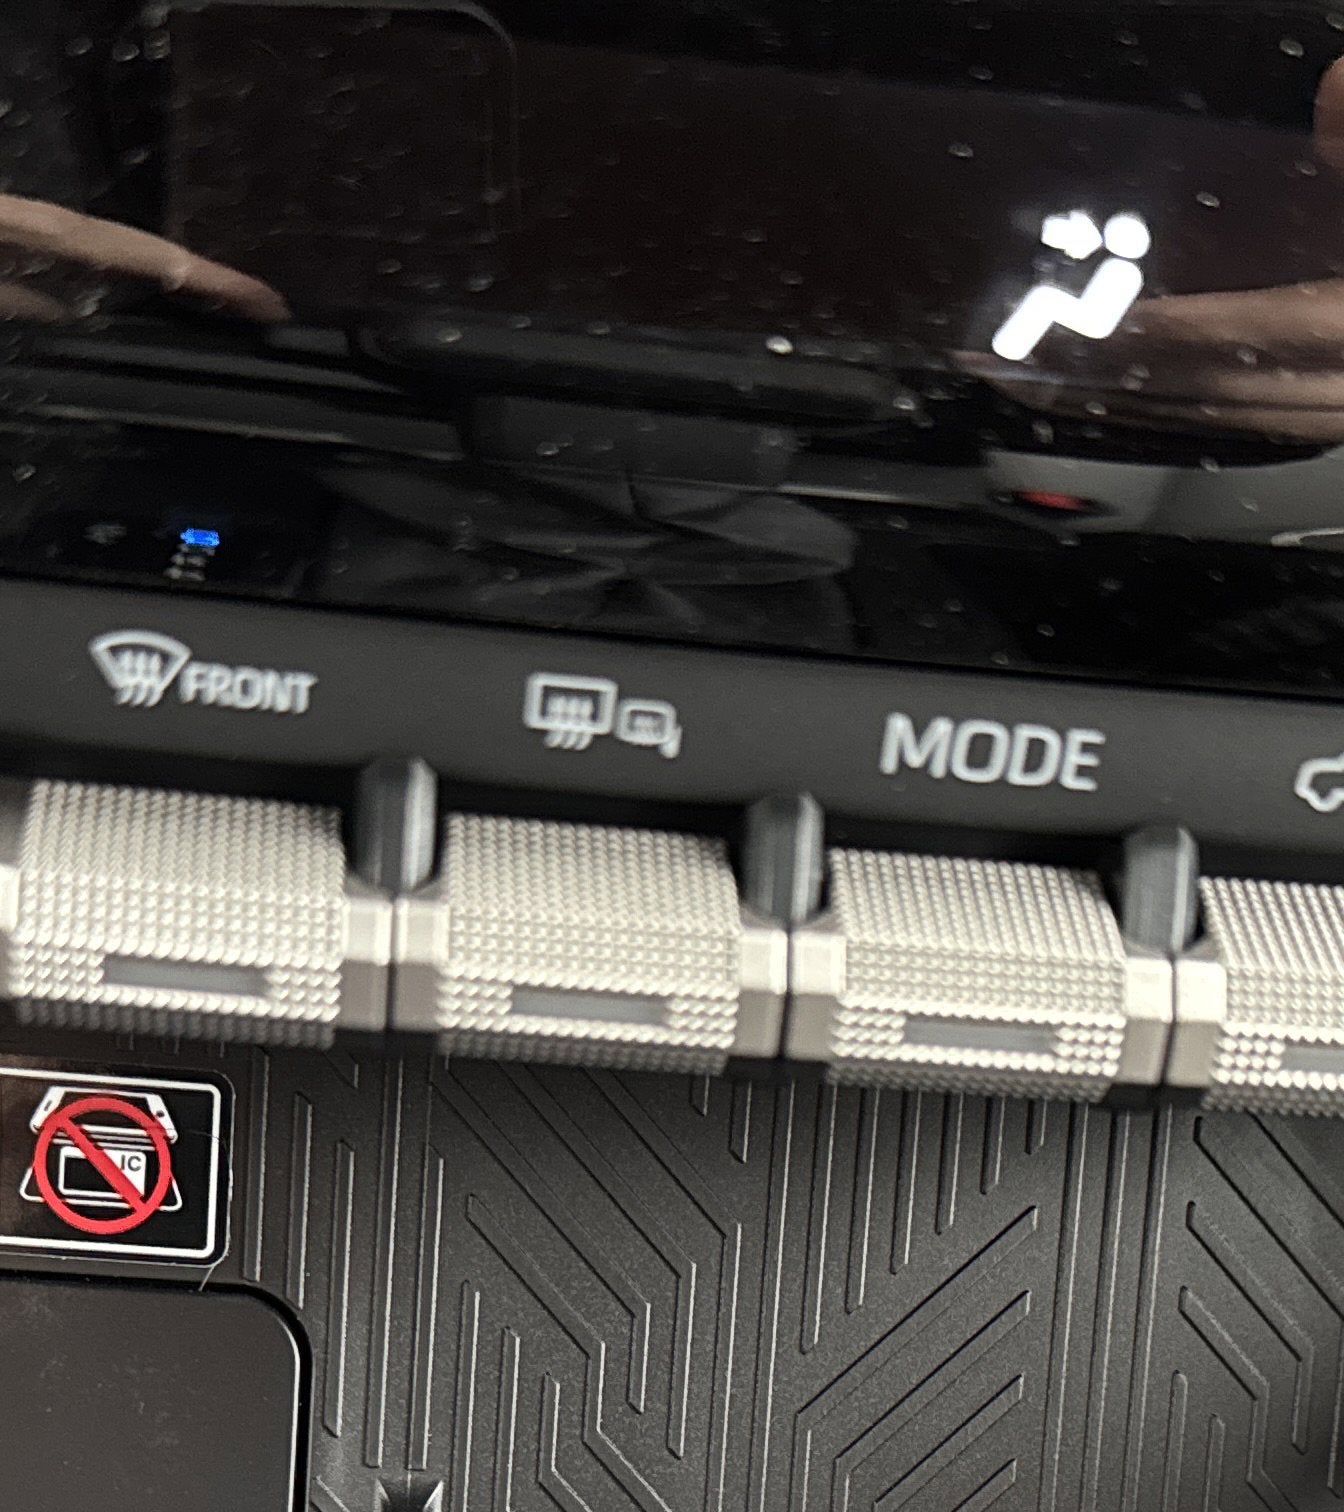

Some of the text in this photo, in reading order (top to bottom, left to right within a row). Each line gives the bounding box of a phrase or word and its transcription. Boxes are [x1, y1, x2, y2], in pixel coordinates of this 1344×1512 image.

[180, 661, 319, 714] FRONT
[879, 712, 1106, 791] MODE
[120, 1154, 142, 1172] IC
